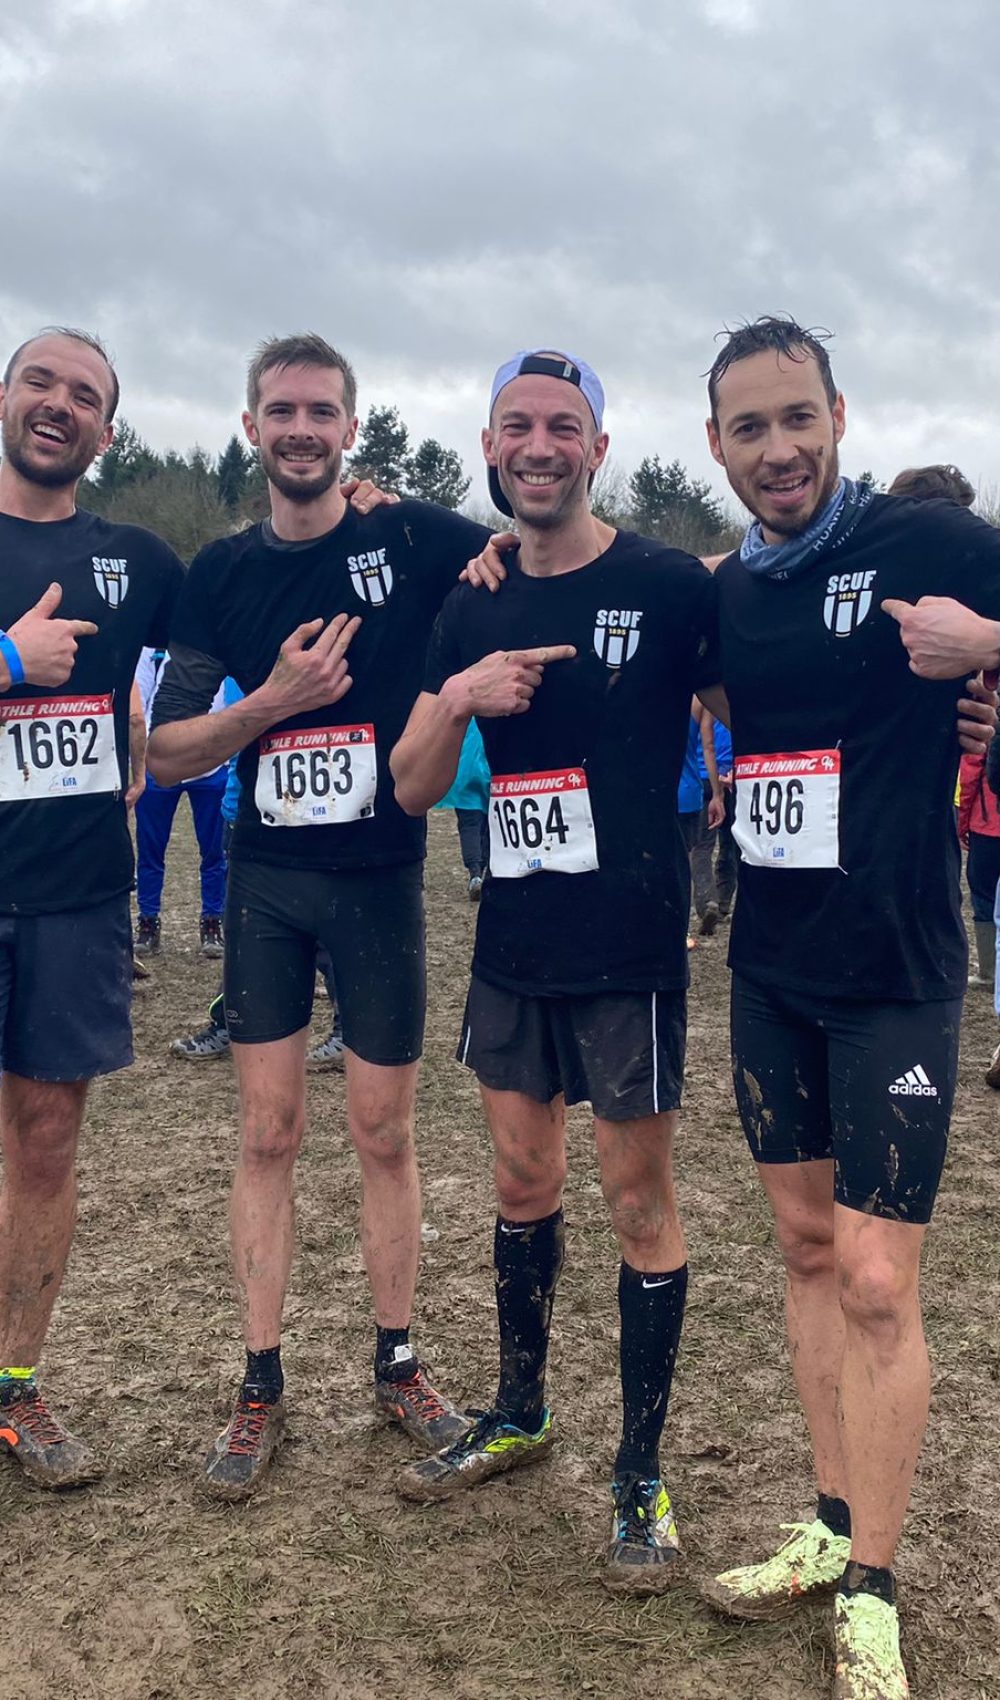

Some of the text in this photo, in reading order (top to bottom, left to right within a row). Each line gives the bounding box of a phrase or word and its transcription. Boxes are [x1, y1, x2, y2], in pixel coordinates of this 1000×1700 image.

[92, 556, 127, 573] SCUF
[347, 547, 386, 572] SCUF
[827, 570, 877, 594] SCUF
[596, 609, 643, 628] SCUF
[38, 702, 100, 714] RUNNING
[8, 718, 98, 770] 1662
[272, 748, 353, 800] 1663
[760, 758, 818, 774] RUNNING
[506, 777, 565, 793] RUNNING
[750, 779, 804, 835] 496
[494, 796, 569, 849] 1664
[888, 1083, 937, 1096] adidas
